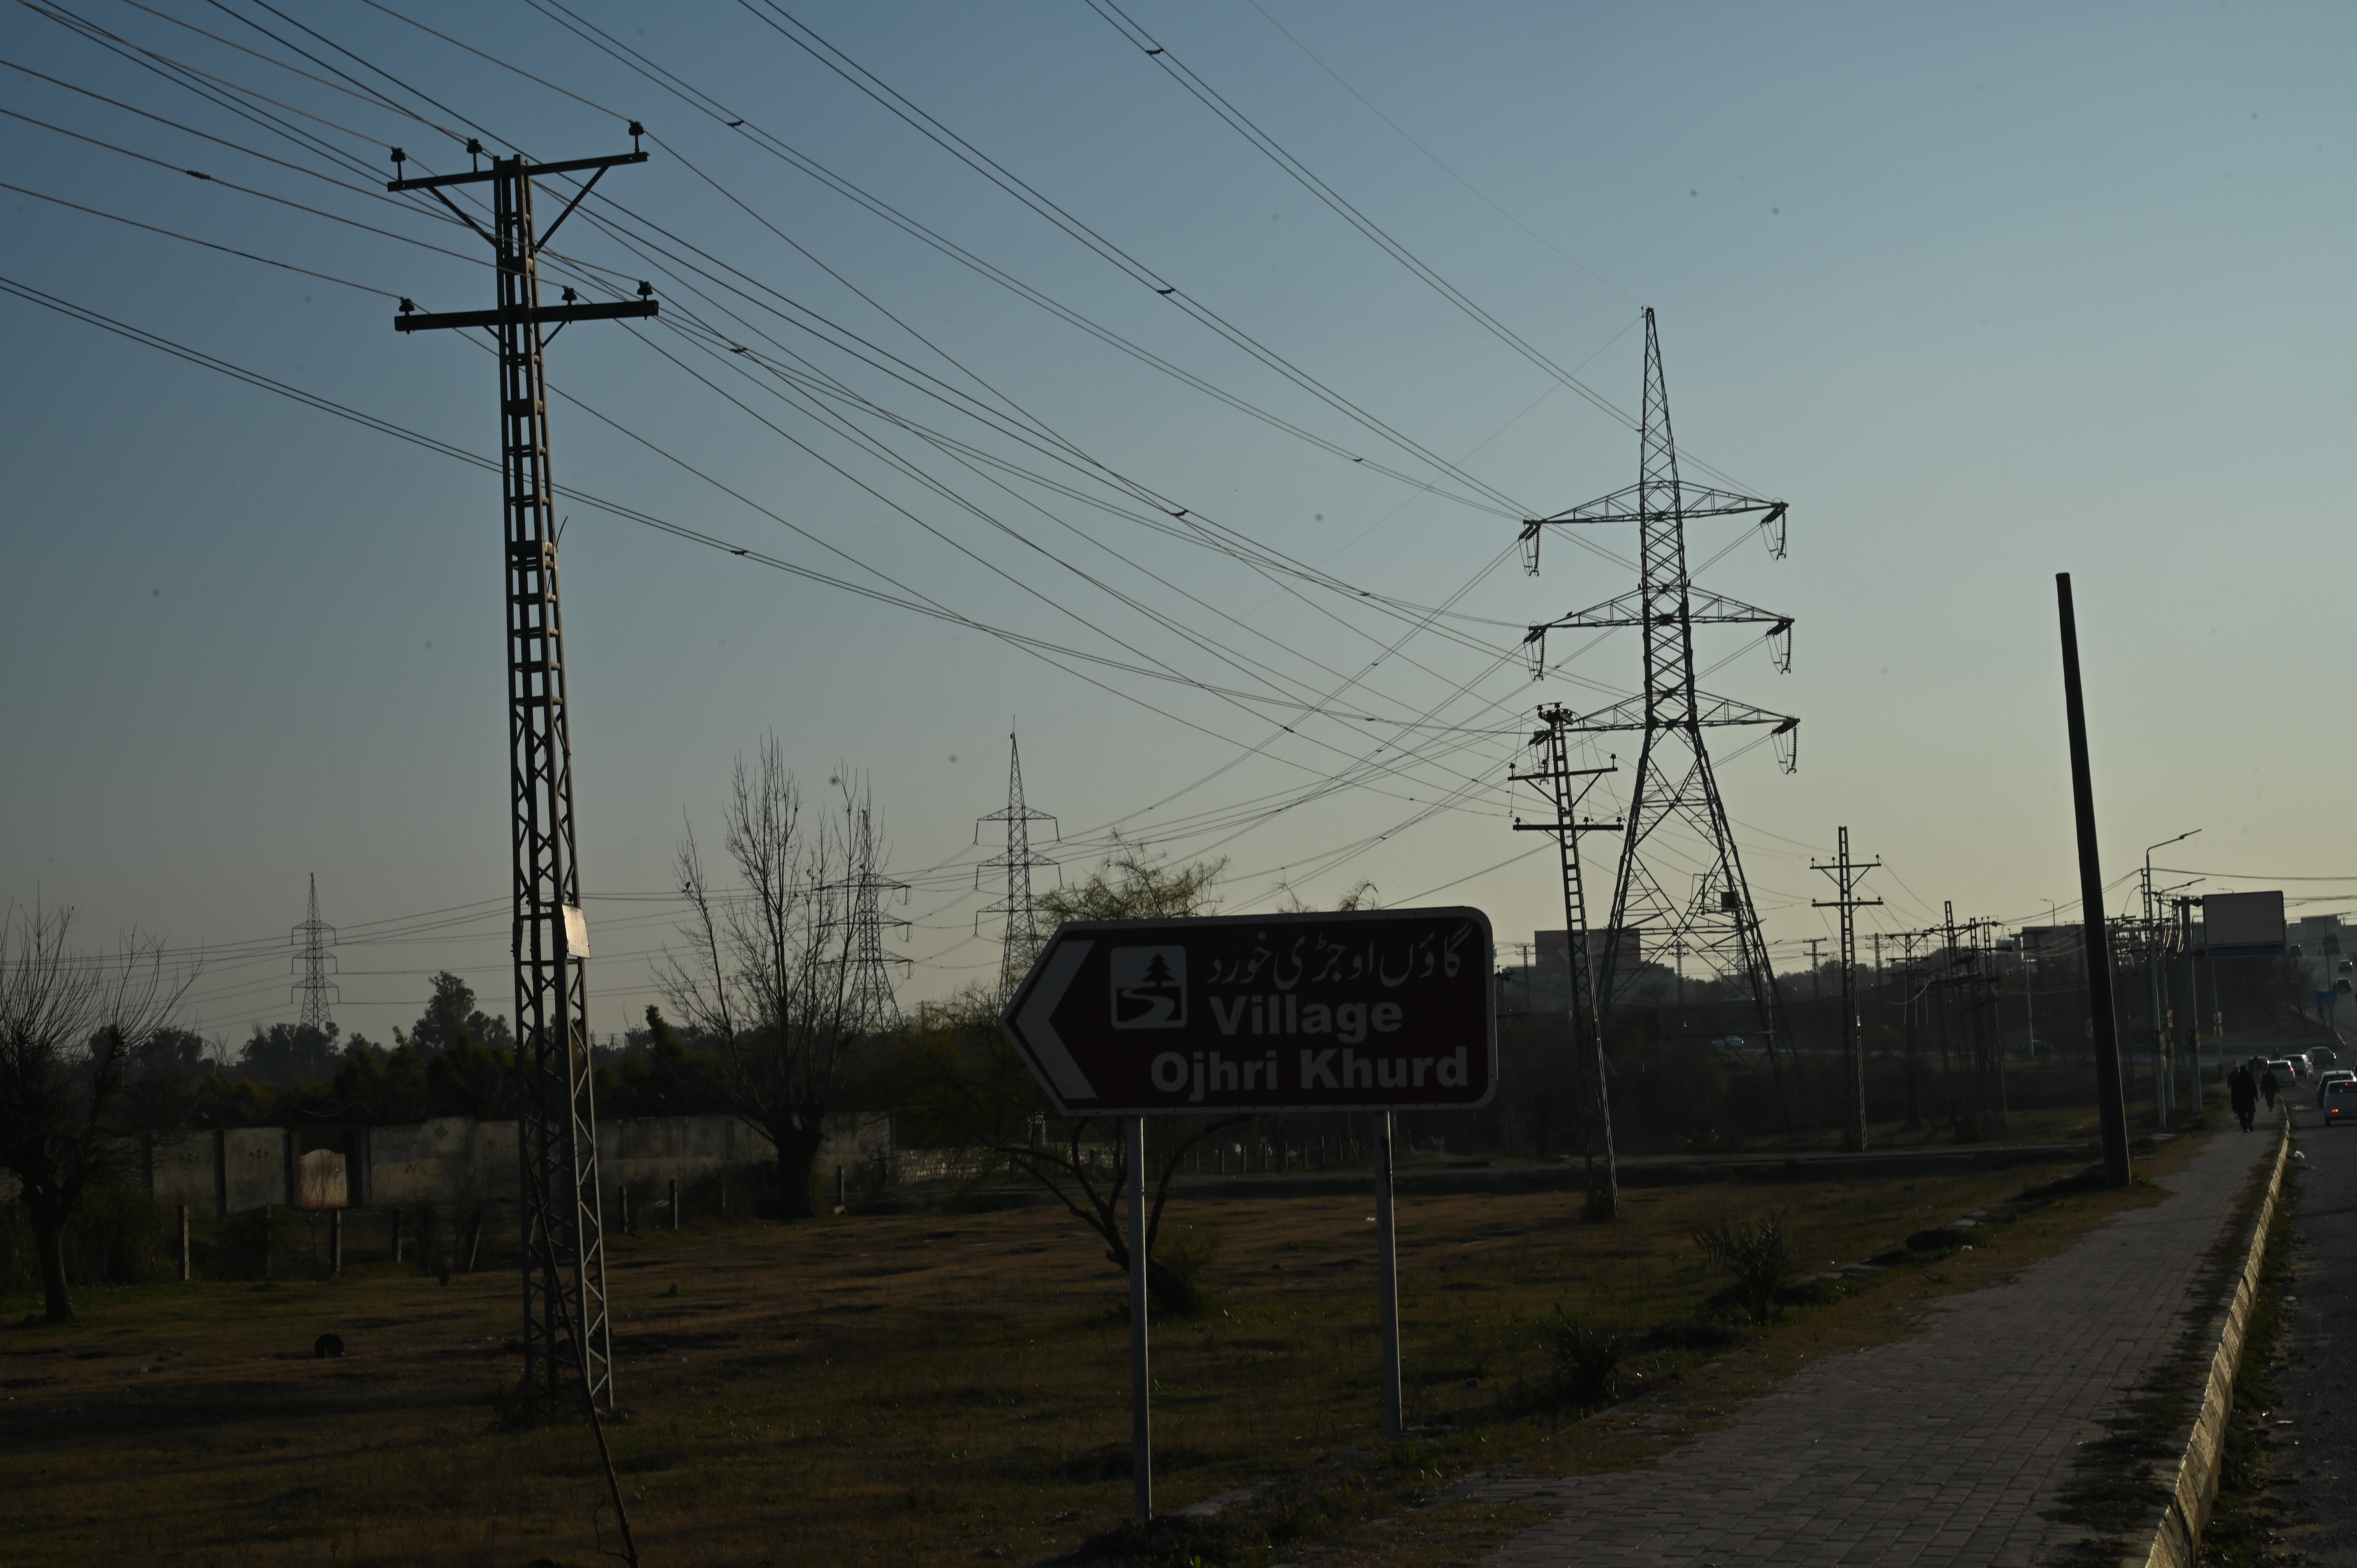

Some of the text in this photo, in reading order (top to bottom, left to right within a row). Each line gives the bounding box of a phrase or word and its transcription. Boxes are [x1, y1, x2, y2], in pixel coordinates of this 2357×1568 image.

[1380, 922, 1472, 987] گاؤں
[1209, 994, 1403, 1044] Village
[1151, 1046, 1468, 1102] Ojhri Khurd
